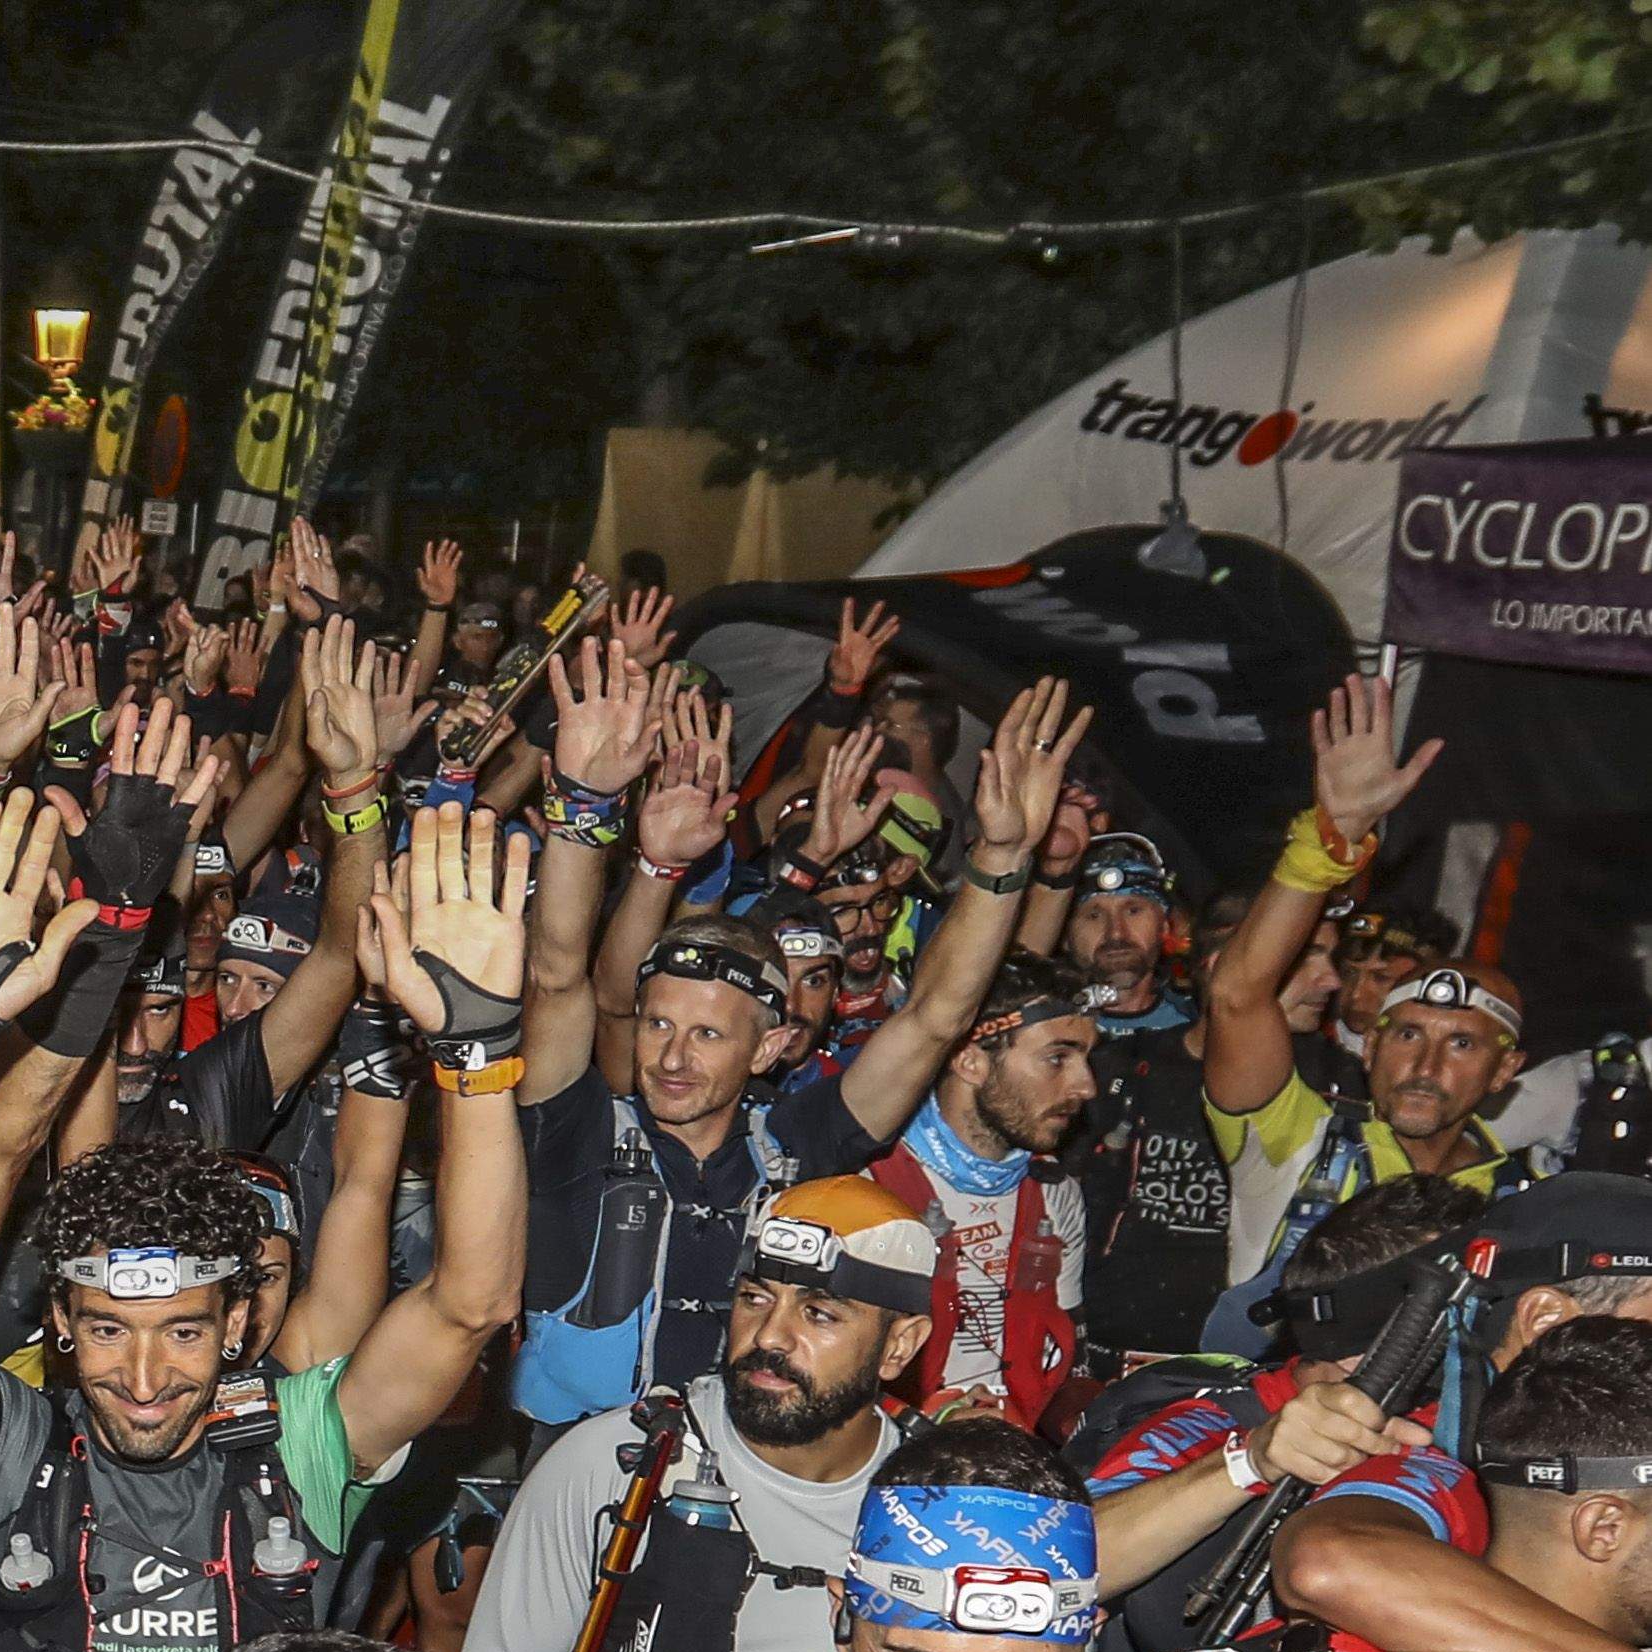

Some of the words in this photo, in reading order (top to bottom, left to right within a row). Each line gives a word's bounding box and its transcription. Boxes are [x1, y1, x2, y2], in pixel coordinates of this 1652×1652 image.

[1399, 480, 1652, 576] CÝCLOP
[1492, 598, 1524, 628] LO
[1529, 599, 1652, 638] IMPORTA
[727, 969, 755, 989] PETZL
[1527, 1465, 1565, 1485] PETZ
[879, 1488, 950, 1558] KARPOS
[890, 1571, 926, 1595] PETZL
